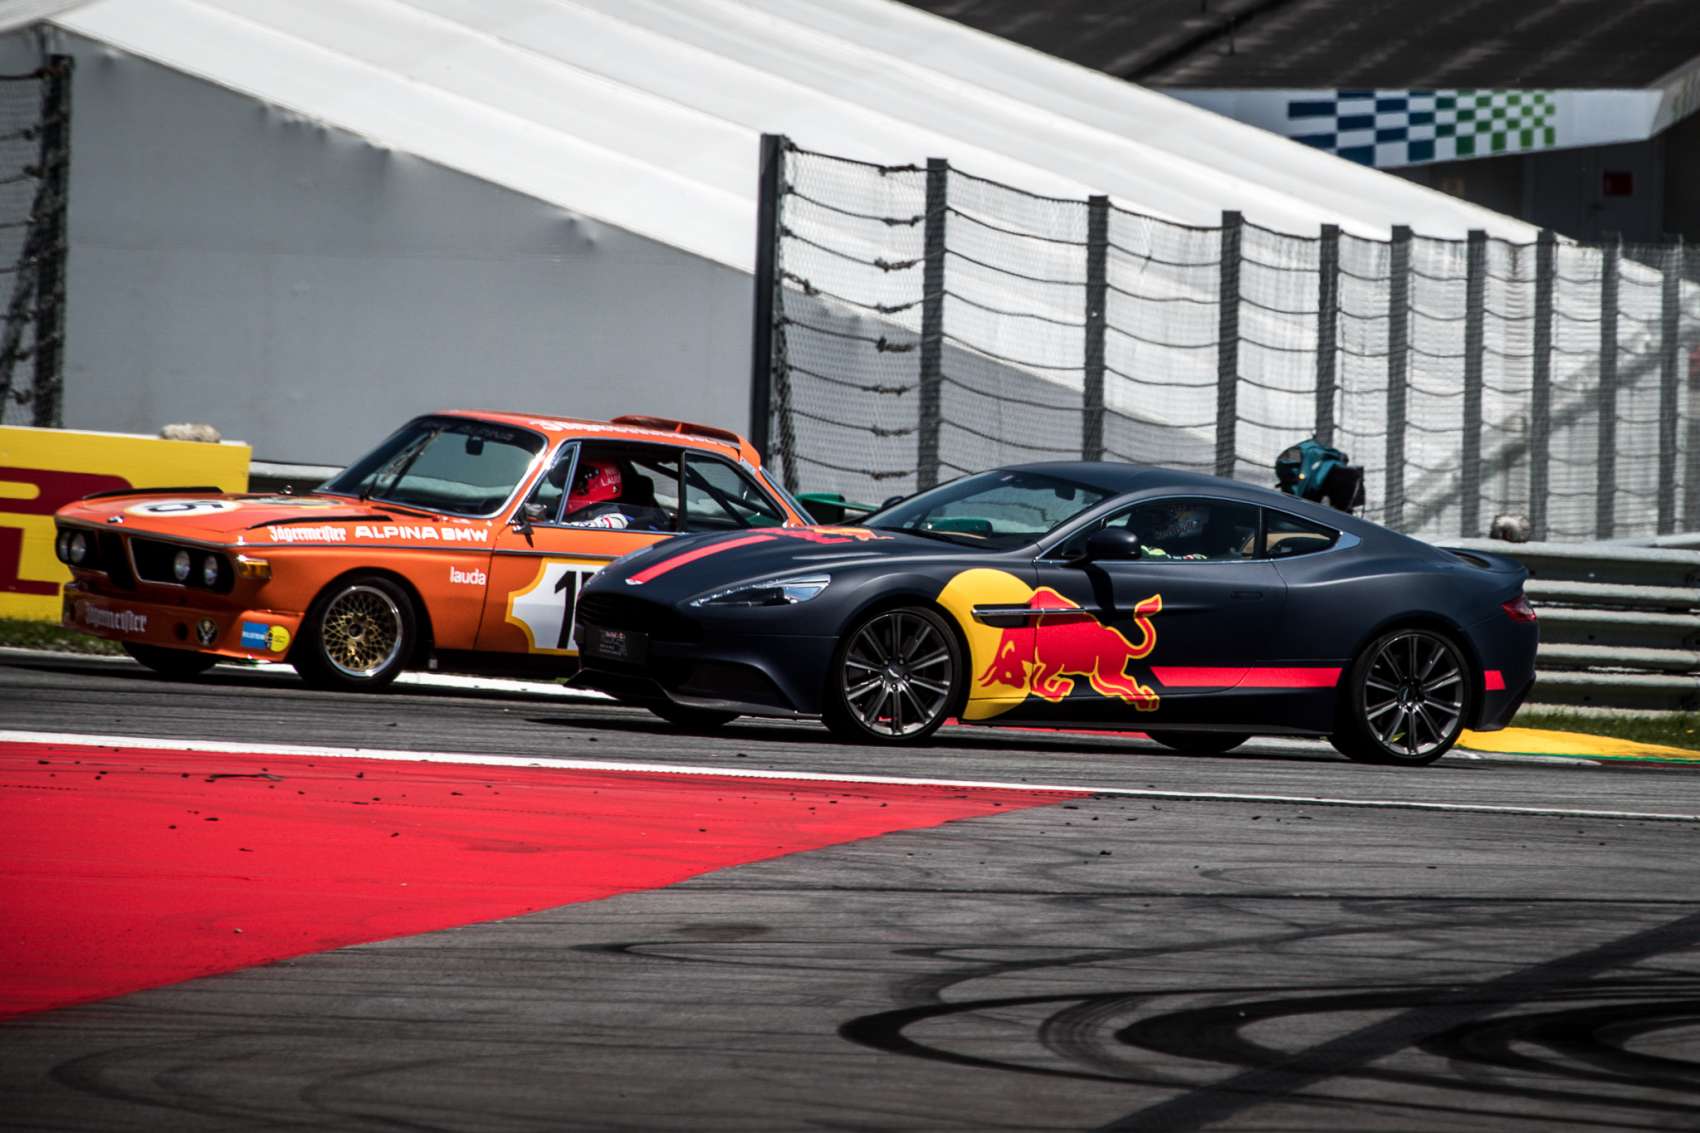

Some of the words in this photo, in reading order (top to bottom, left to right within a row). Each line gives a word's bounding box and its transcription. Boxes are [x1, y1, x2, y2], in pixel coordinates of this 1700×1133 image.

[355, 526, 439, 539] ALPINA
[441, 527, 488, 542] BMW
[450, 566, 487, 586] lauda
